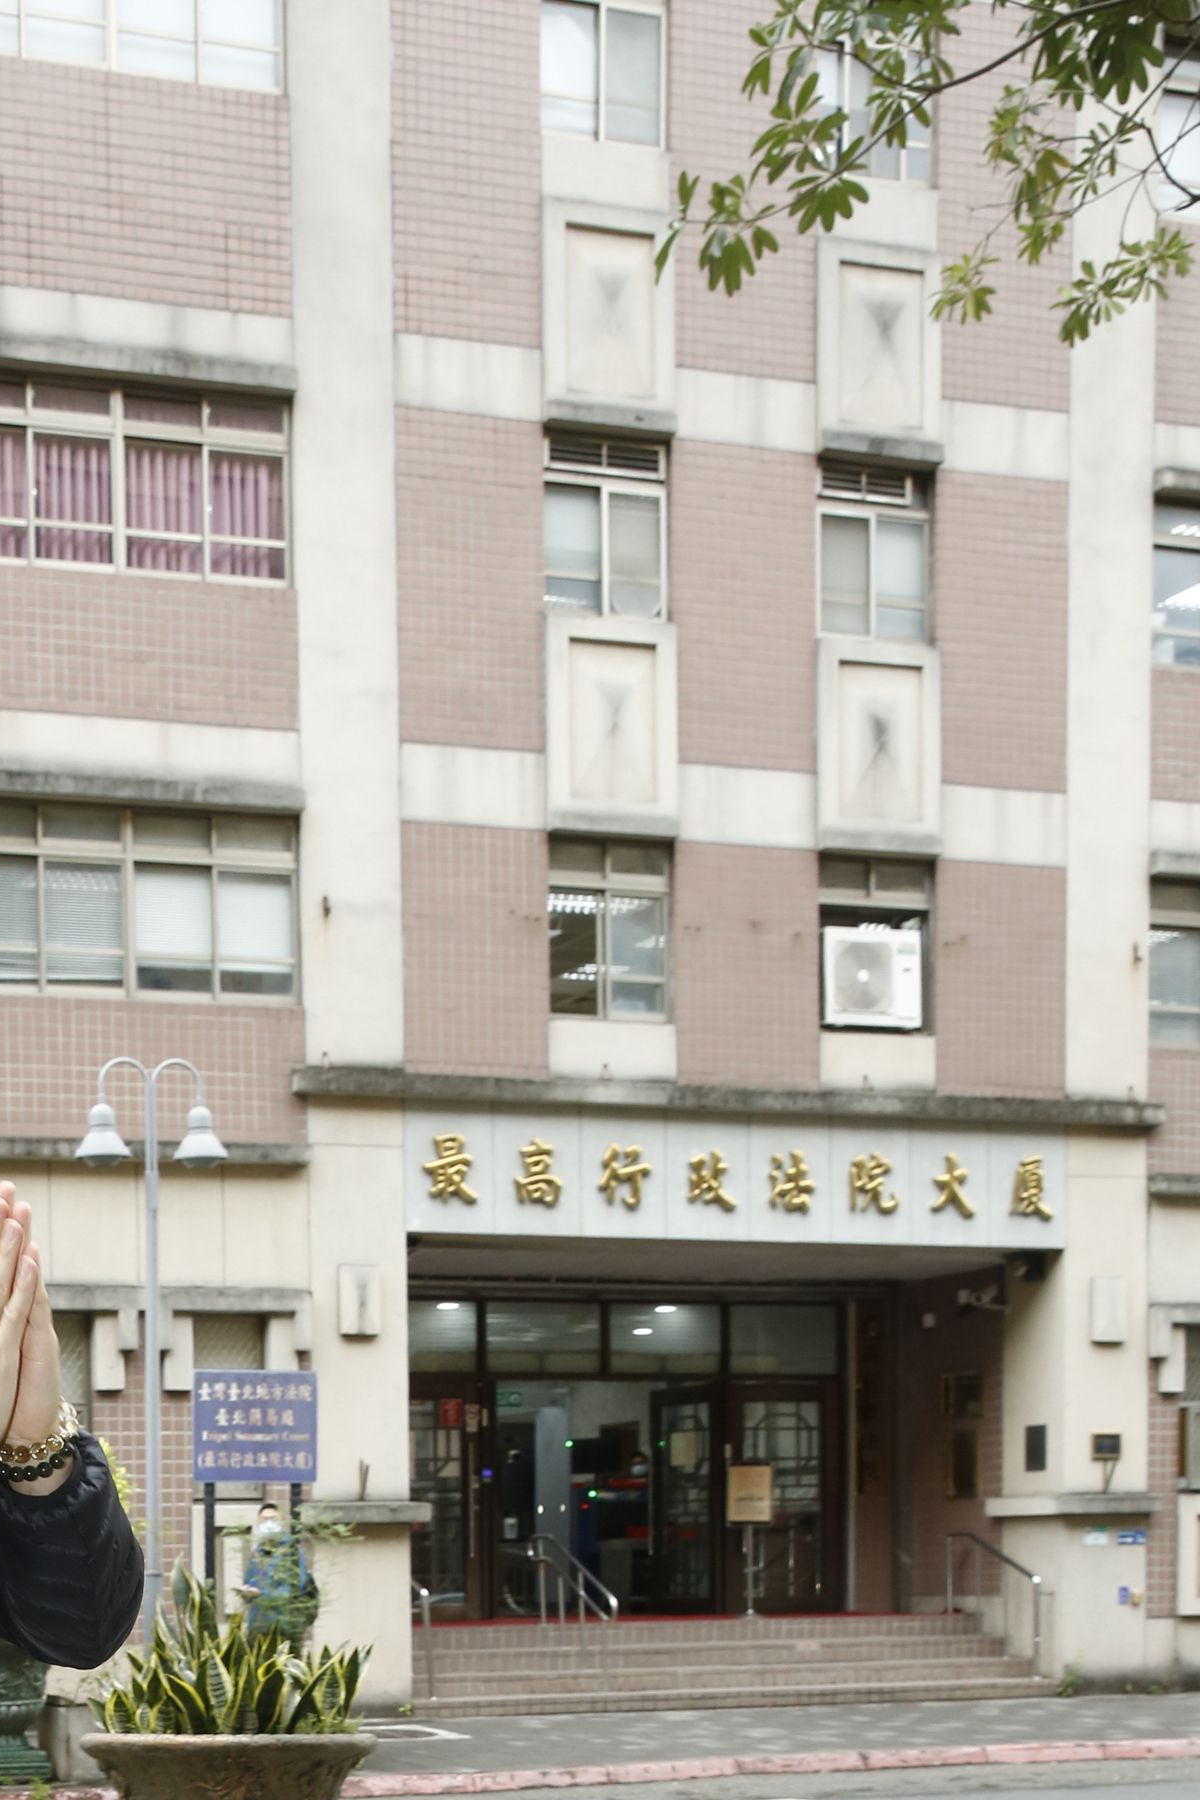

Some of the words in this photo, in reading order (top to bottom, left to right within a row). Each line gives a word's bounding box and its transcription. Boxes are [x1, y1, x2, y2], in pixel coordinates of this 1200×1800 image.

[423, 1133, 1054, 1221] 最高行政法院大廈
